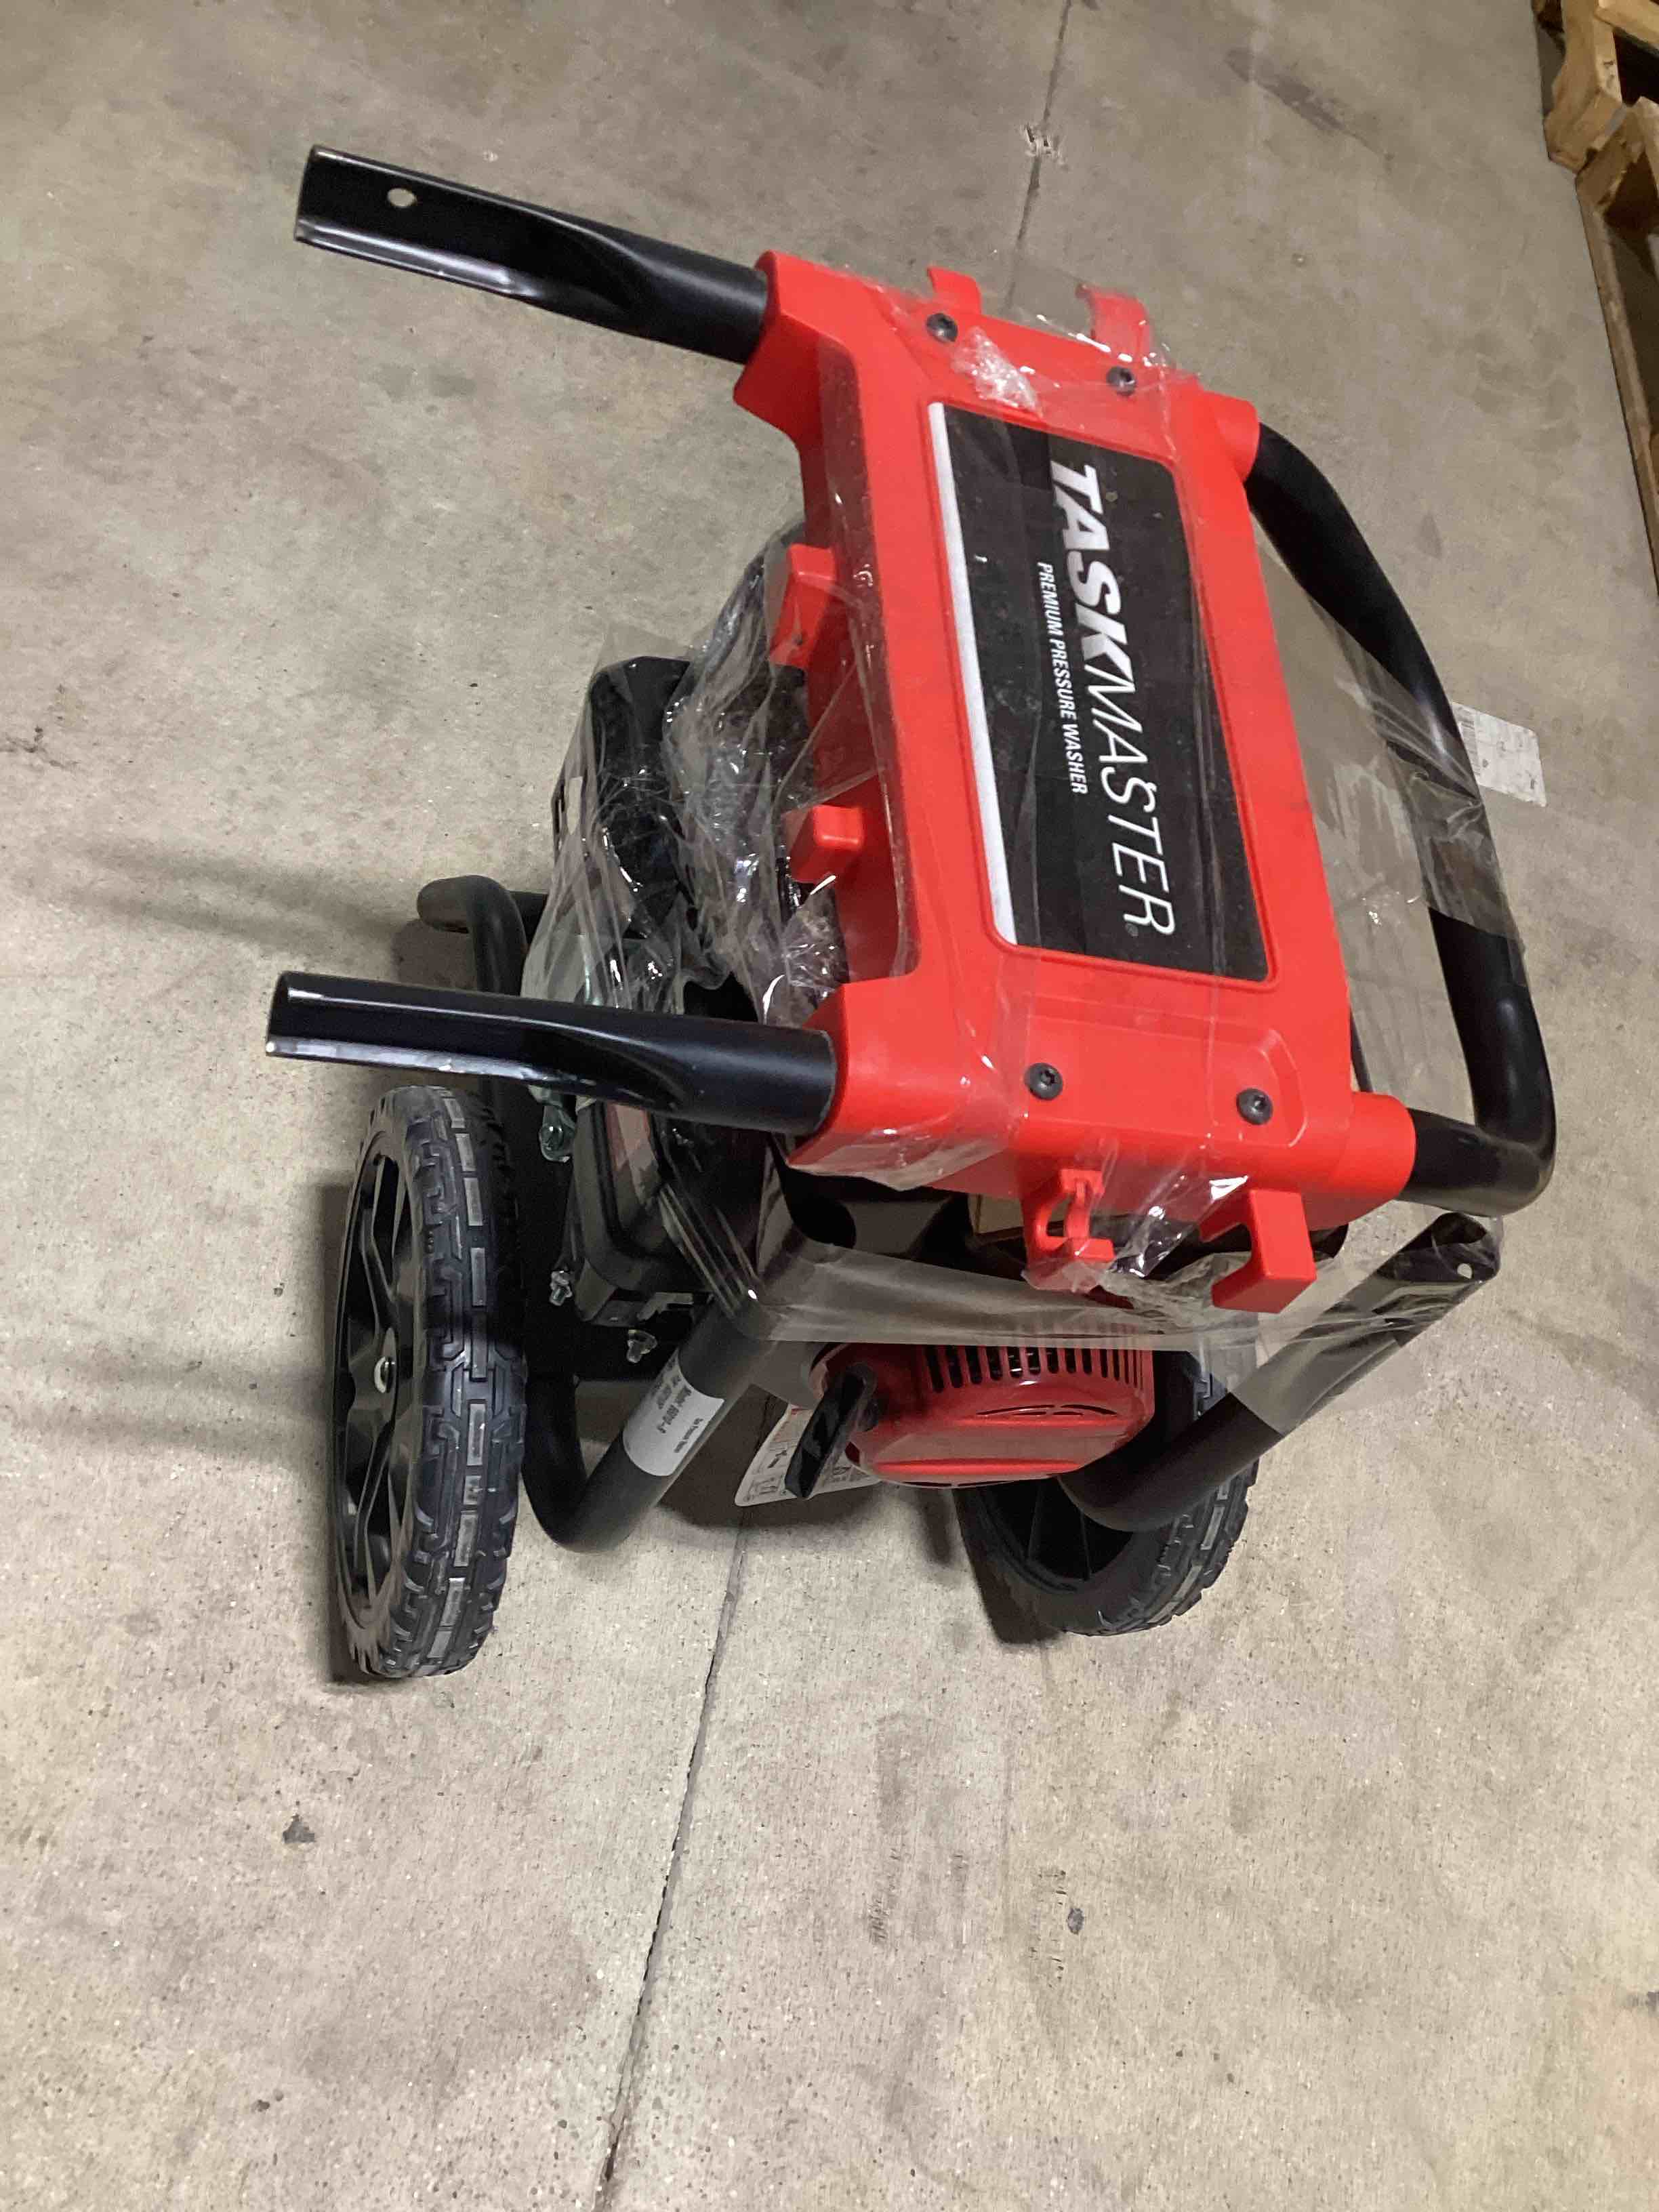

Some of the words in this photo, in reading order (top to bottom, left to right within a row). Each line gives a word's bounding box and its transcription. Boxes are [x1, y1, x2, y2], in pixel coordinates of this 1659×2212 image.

[1038, 562, 1063, 636] PREMIUM
[1049, 638, 1077, 720] PRESSURE
[1050, 460, 1175, 935] TASKMASTER
[1061, 723, 1088, 794] WASHER
